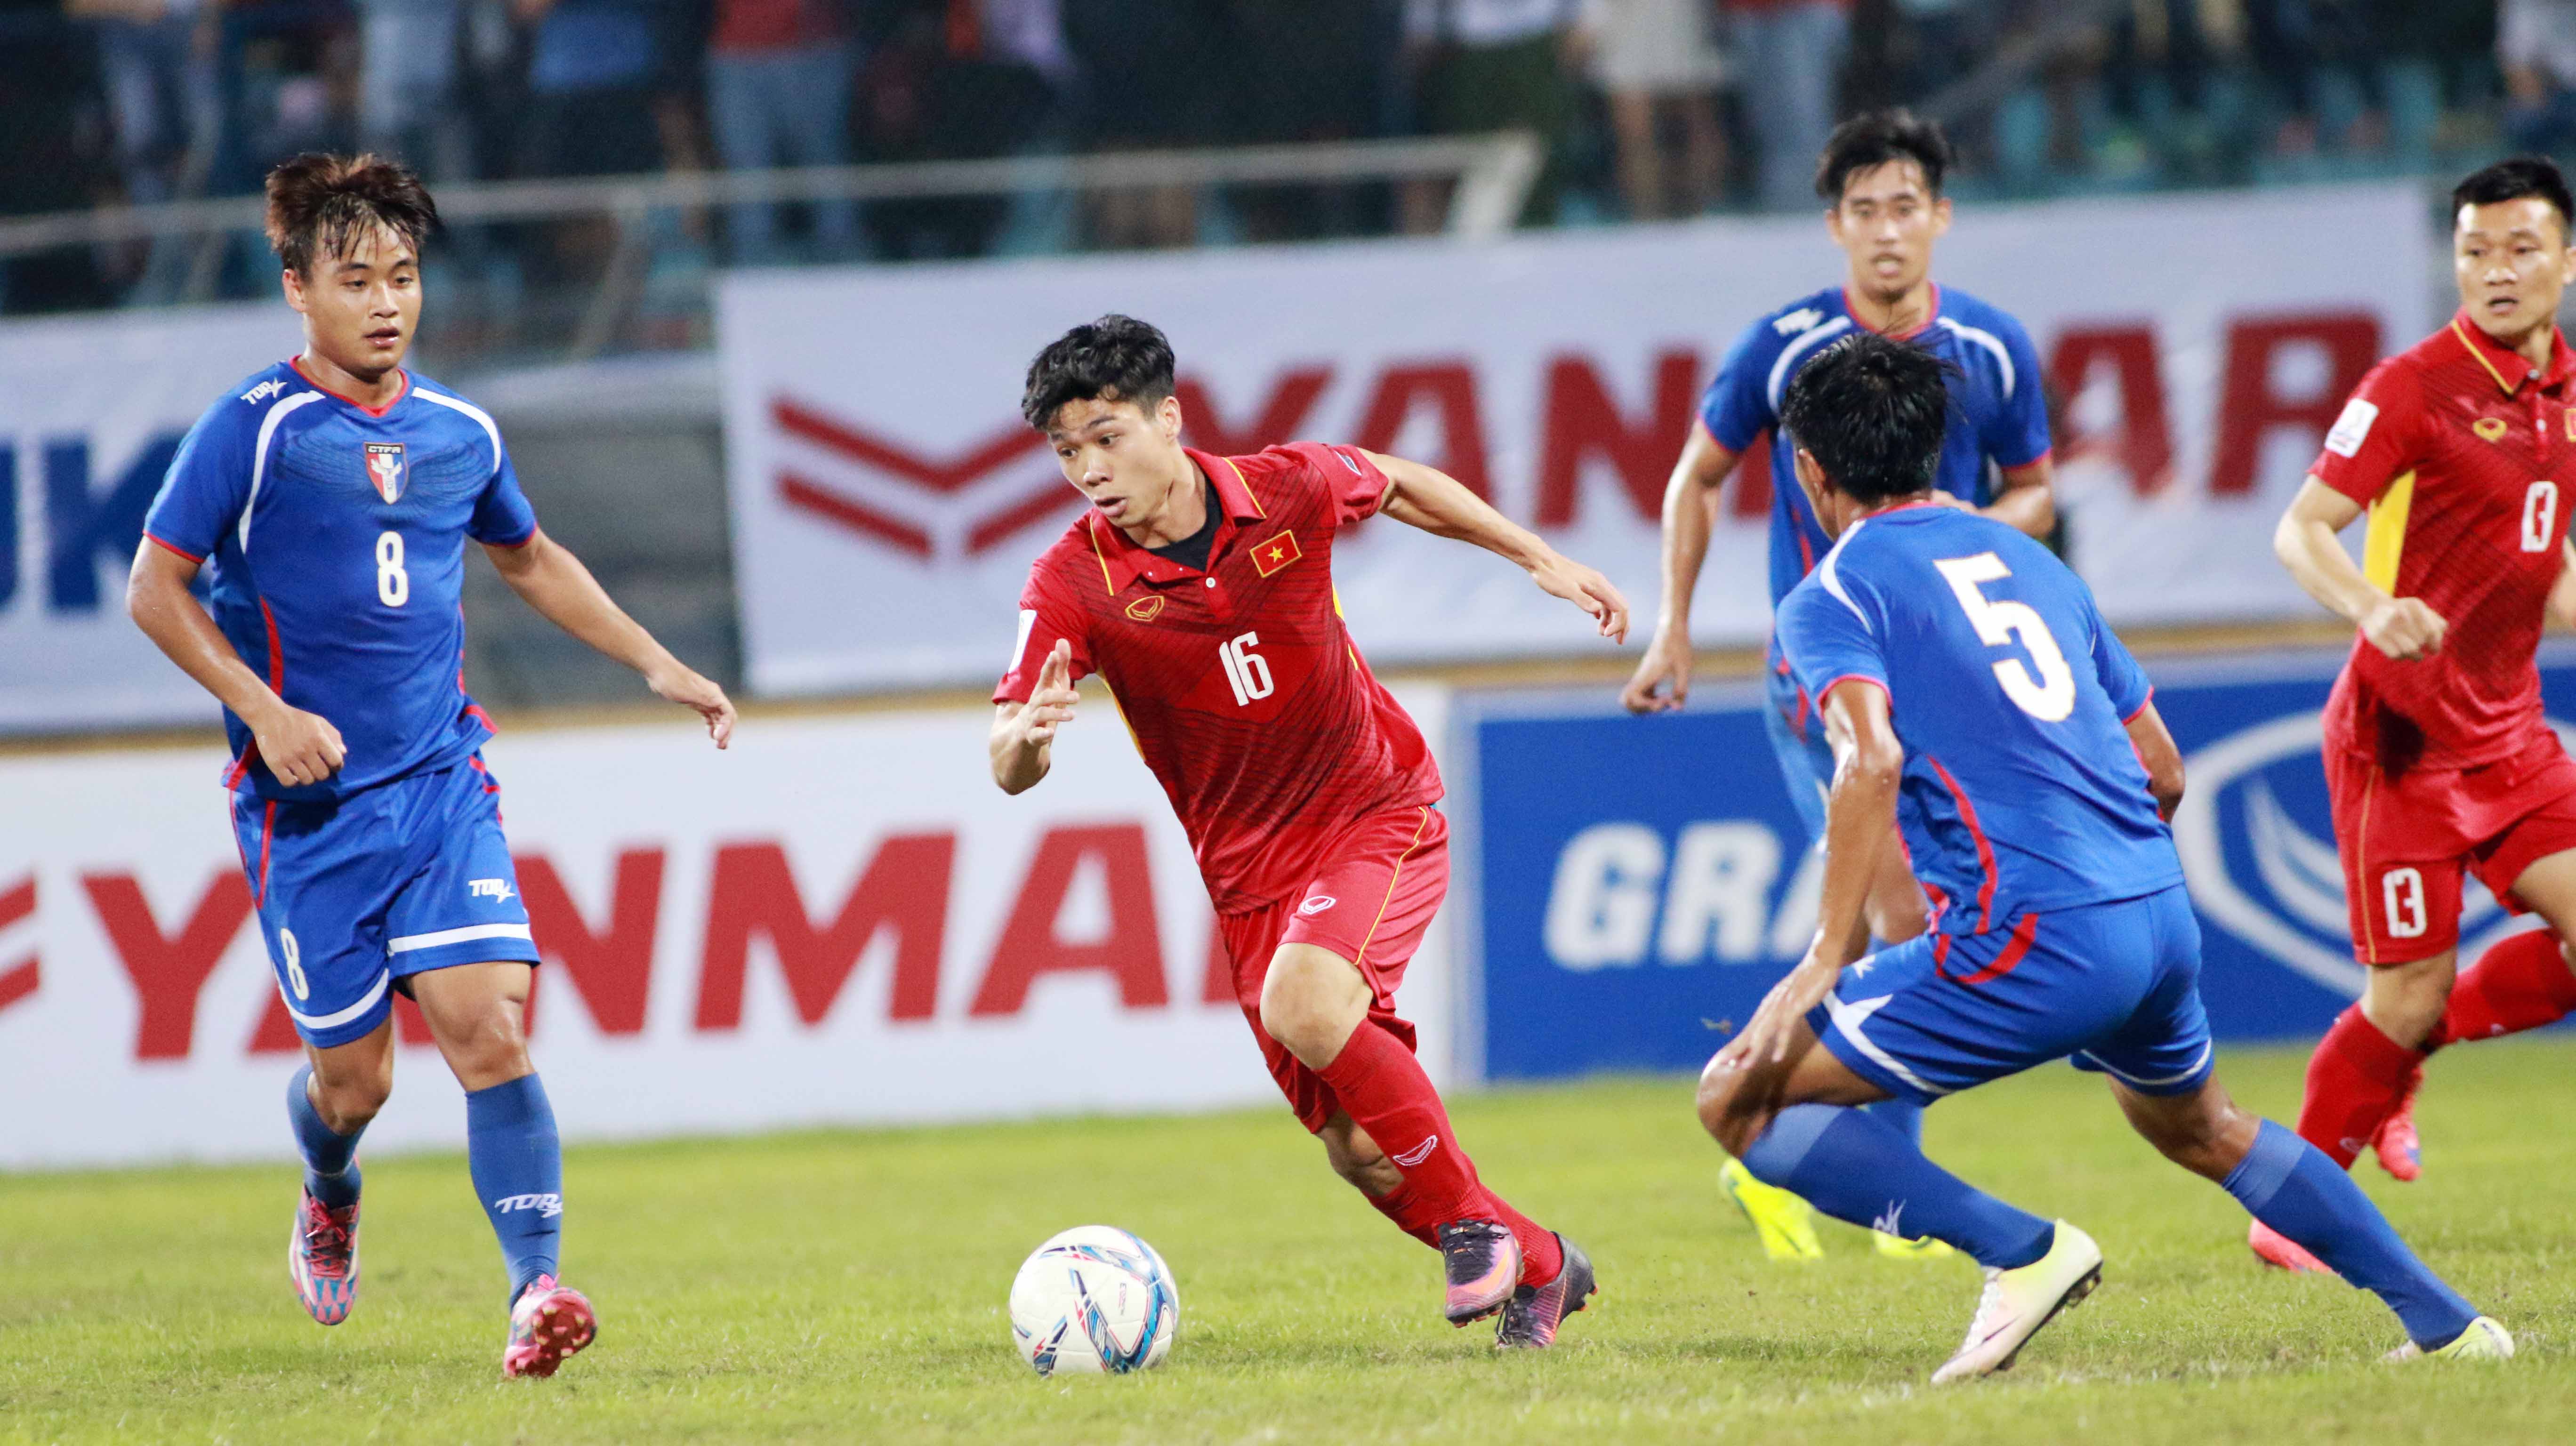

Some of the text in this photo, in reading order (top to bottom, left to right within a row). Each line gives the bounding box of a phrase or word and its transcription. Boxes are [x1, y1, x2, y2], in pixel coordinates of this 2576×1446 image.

[1173, 313, 2381, 541] YANAR
[376, 530, 409, 607] 8
[1219, 631, 1274, 707] 16
[1932, 551, 2076, 722] 5
[2383, 868, 2427, 938] 13
[81, 824, 1244, 1063] YNMA
[281, 928, 309, 1000] 8
